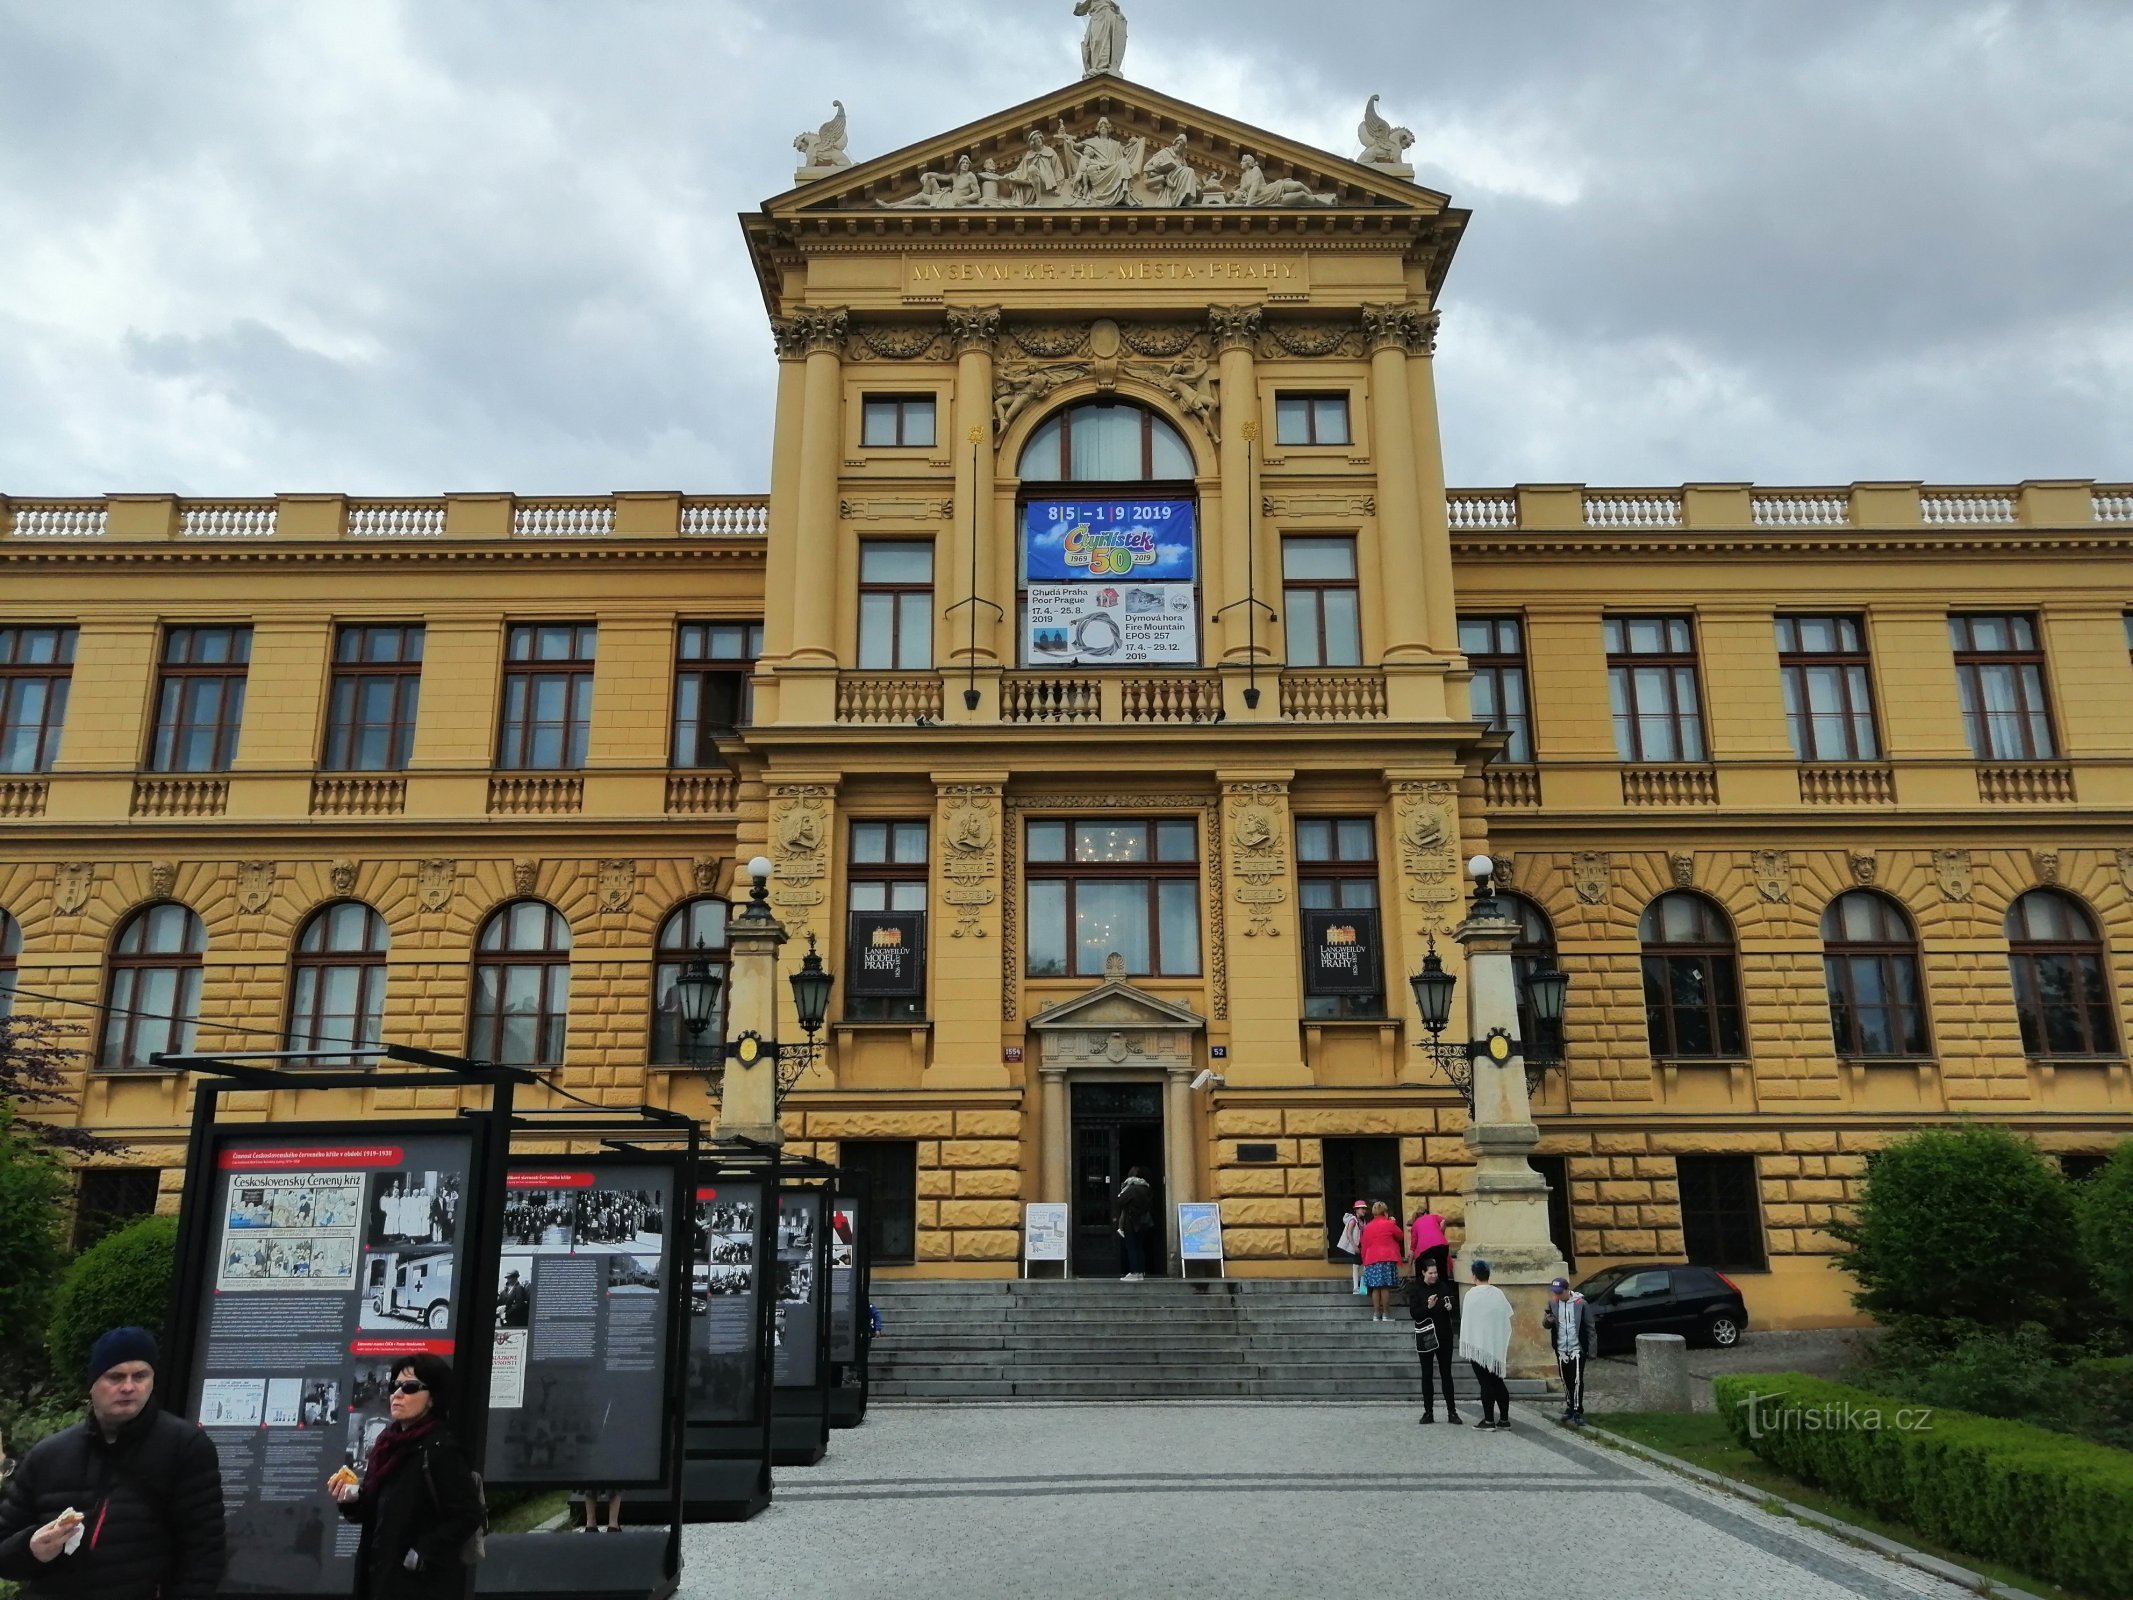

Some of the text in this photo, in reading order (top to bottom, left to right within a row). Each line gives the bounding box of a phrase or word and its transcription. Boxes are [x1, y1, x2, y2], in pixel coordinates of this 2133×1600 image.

[1070, 555, 1088, 563] 1969
[1089, 547, 1133, 574] 50
[1134, 554, 1152, 562] 2019
[1032, 588, 1089, 597] Chudá Praha
[1054, 596, 1085, 606] Prague
[1032, 615, 1053, 623] 2019
[1125, 614, 1183, 623] Dýmová hora
[1125, 623, 1186, 631] Fire Mountain
[1125, 632, 1170, 640] EPOS 257
[1125, 652, 1147, 660] 2019
[865, 954, 896, 962] MODEL
[1320, 952, 1352, 960] MODEL
[864, 961, 895, 970] PRAHY
[1321, 959, 1352, 968] PRAHY
[1213, 1048, 1224, 1056] 52
[234, 1172, 361, 1189] Československý Červený kříž
